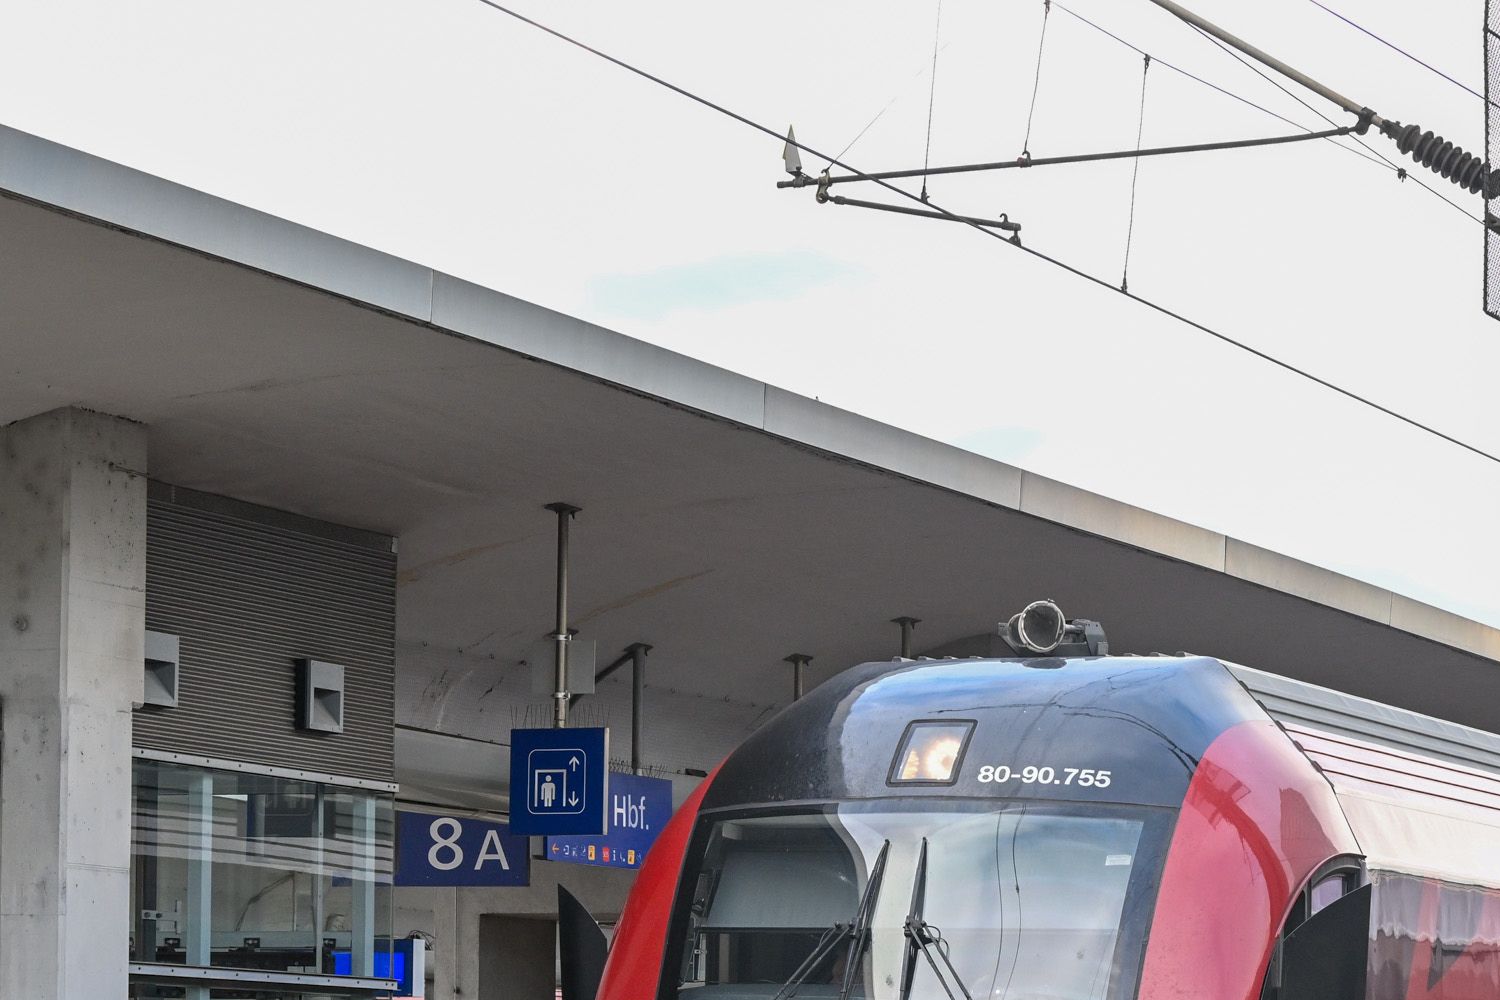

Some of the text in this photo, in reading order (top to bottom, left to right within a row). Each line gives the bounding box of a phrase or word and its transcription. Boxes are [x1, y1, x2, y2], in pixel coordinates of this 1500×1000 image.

[977, 765, 1111, 788] 80-90.755
[613, 794, 650, 831] Hbf.
[427, 817, 510, 871] 8 A
